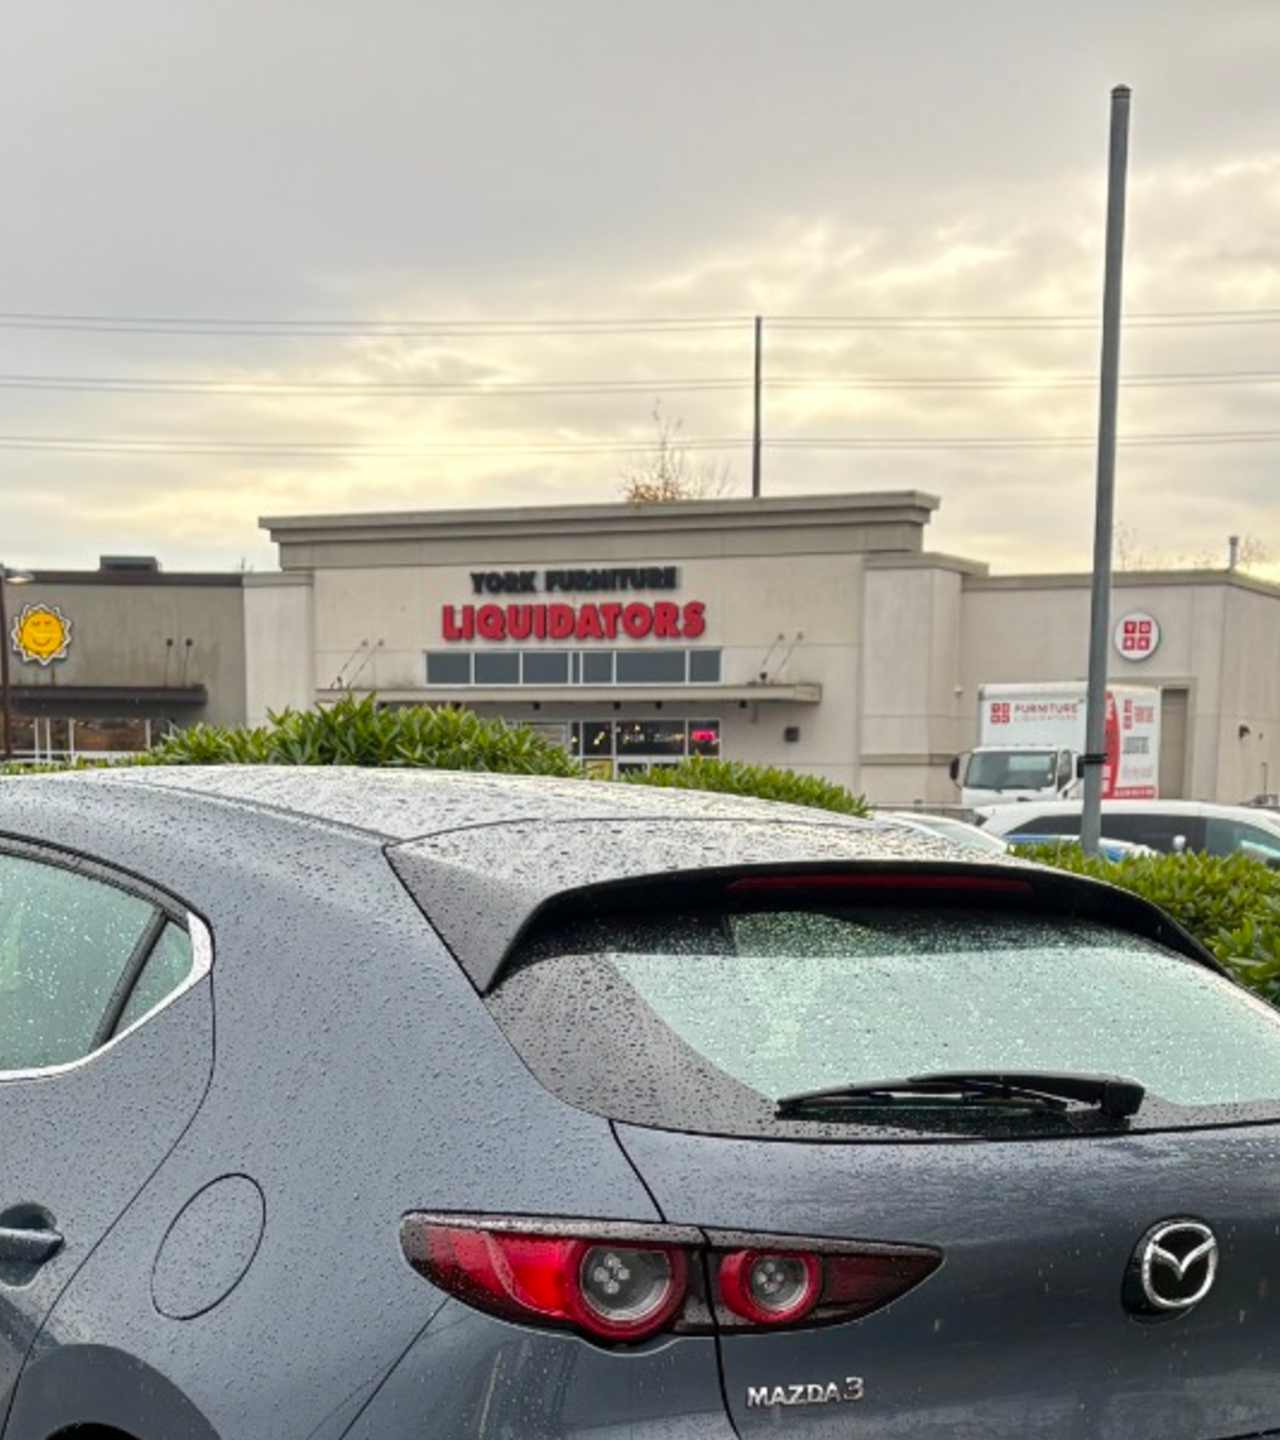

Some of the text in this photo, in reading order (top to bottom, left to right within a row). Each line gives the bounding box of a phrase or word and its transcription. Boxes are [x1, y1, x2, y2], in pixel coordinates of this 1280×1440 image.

[471, 566, 678, 594] YORK FURNITURE
[442, 601, 707, 642] LIQUIDATORS
[1015, 703, 1078, 713] FURNITURE
